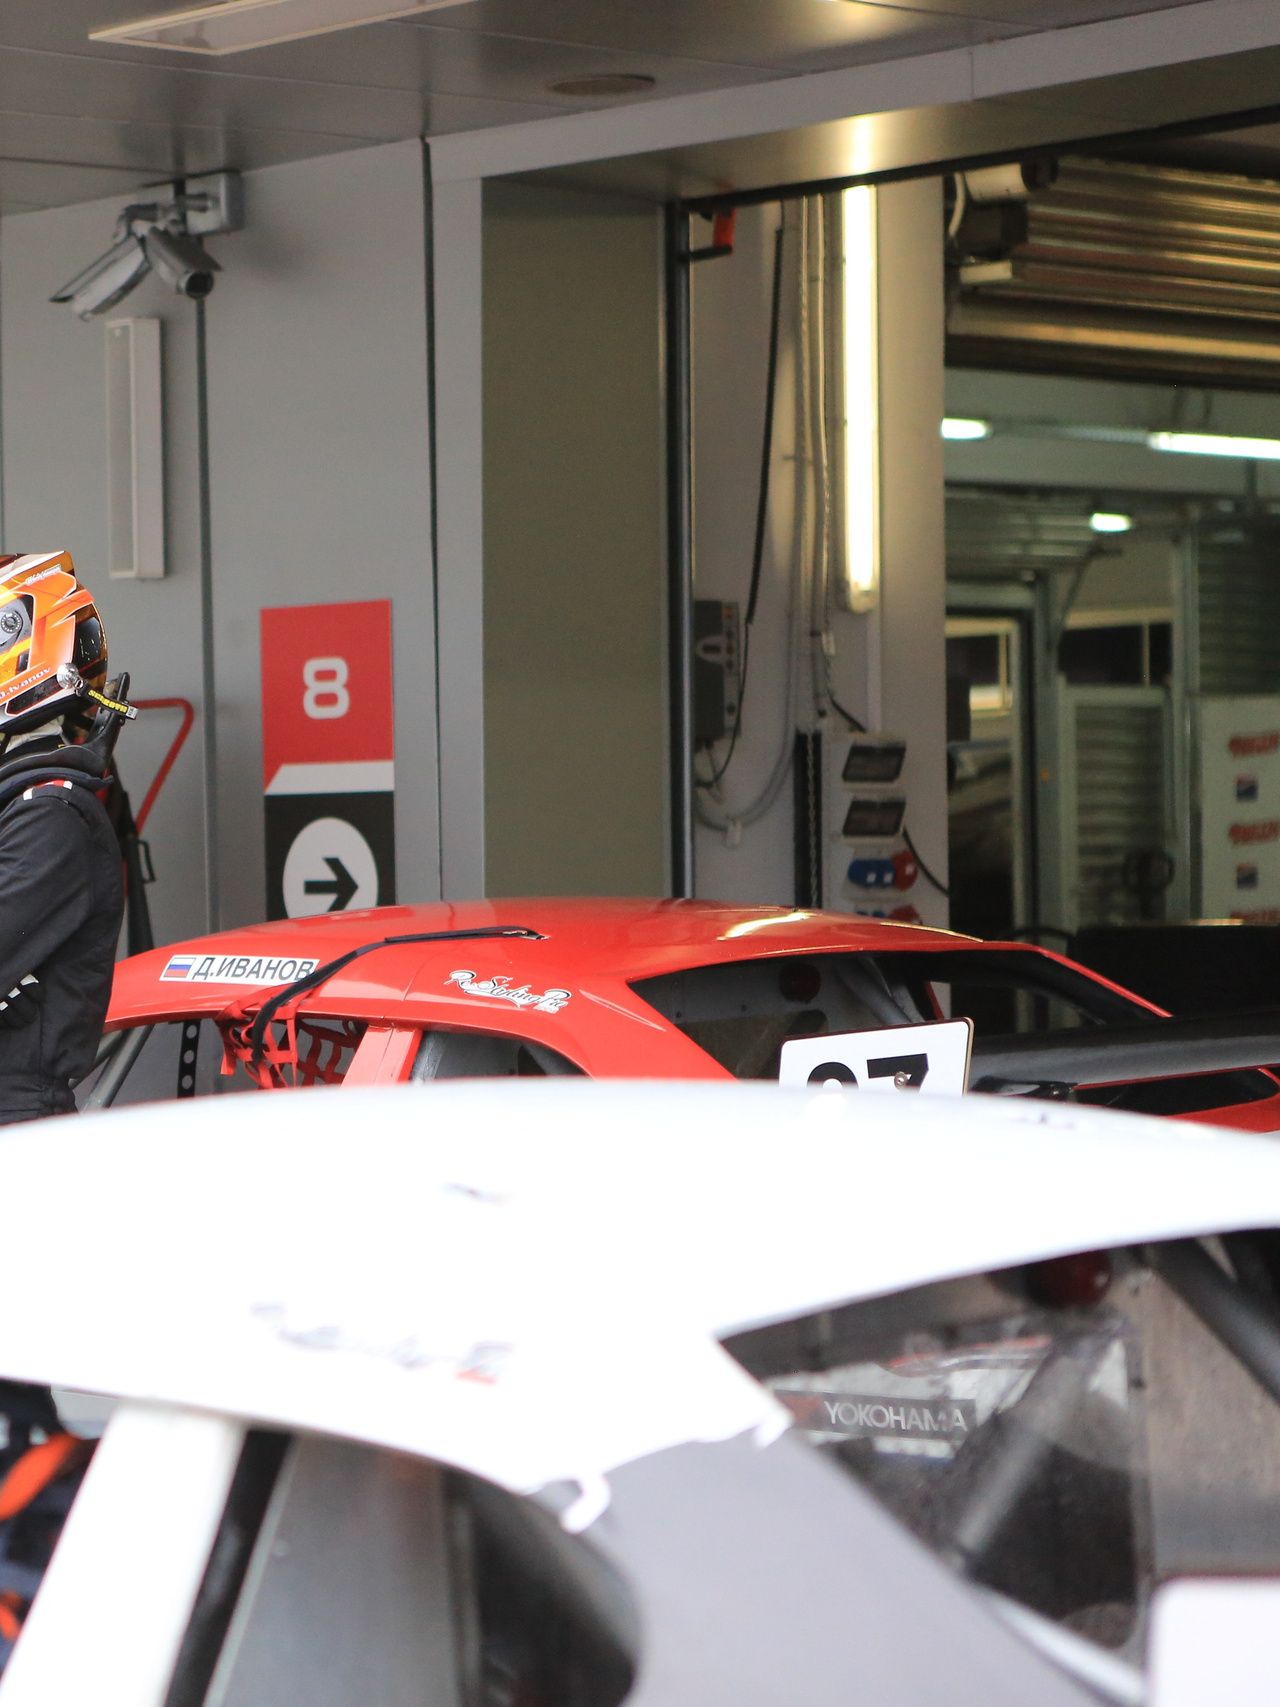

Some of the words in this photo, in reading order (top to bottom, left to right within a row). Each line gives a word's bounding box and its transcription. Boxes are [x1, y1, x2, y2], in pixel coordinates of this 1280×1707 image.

[303, 657, 350, 720] 8
[192, 956, 314, 981] Д.ИВАНОВ
[824, 1401, 969, 1431] YOKOHAMA
